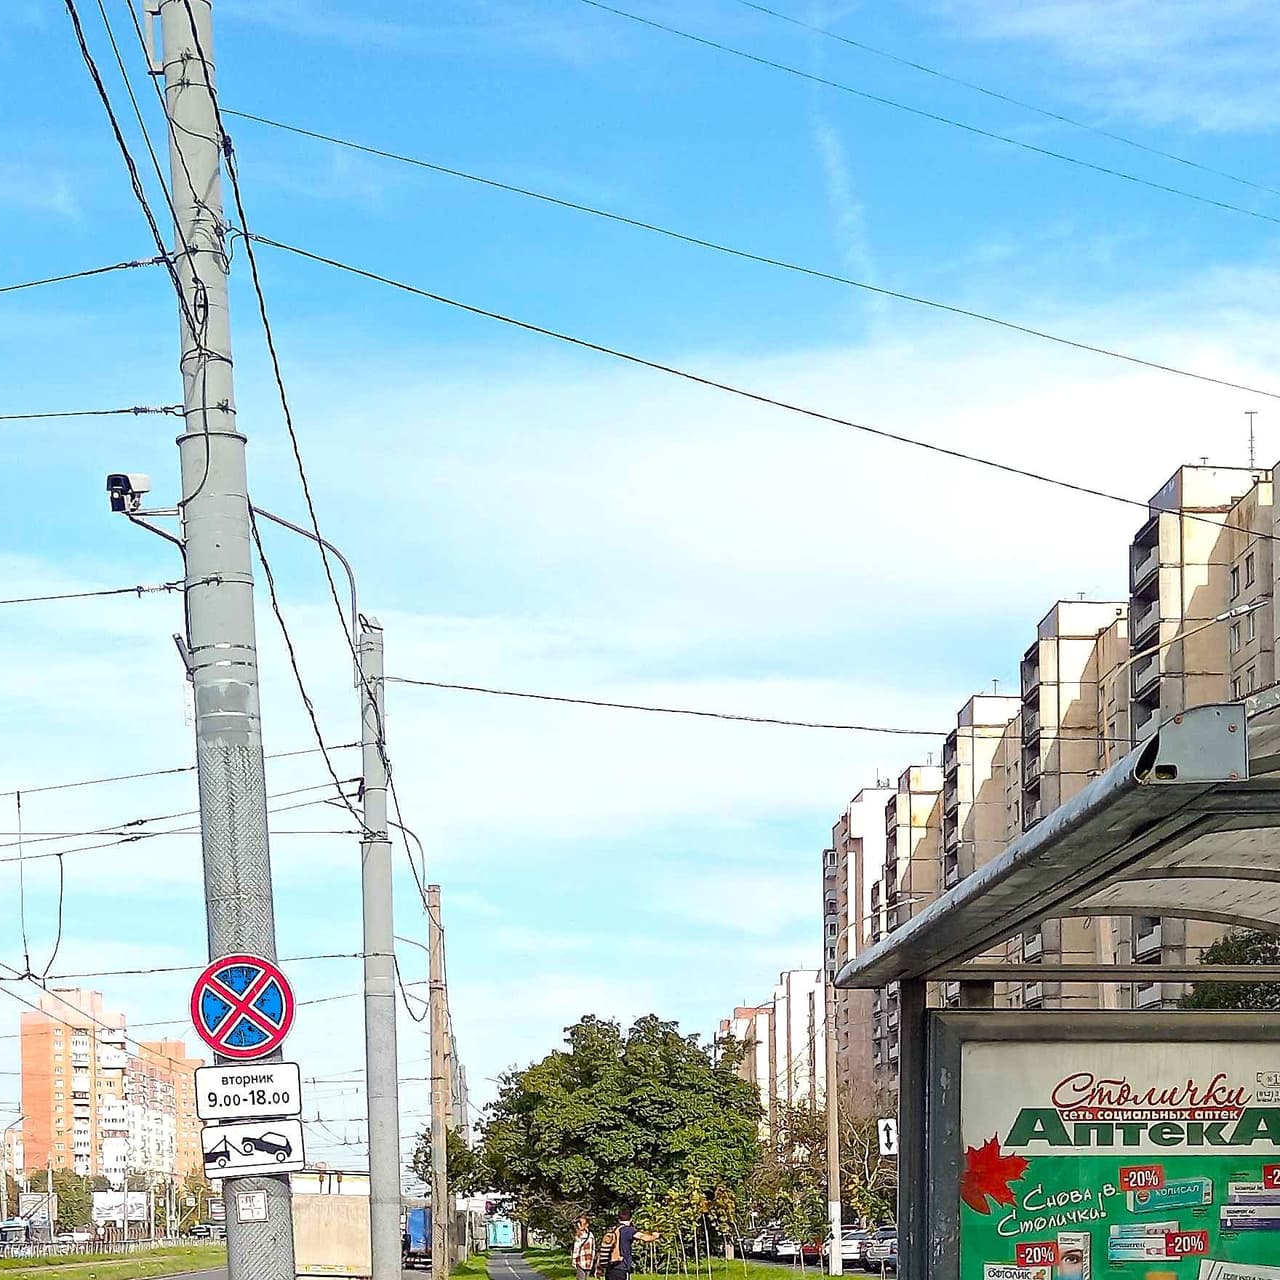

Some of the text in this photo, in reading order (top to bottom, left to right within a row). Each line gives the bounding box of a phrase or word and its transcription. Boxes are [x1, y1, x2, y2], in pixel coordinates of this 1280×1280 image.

[221, 1074, 274, 1088] вторник
[208, 1089, 290, 1108] 9.00-18.00
[1051, 1072, 1253, 1108] Столички
[1062, 1109, 1239, 1121] сеть социальных аптек
[1123, 1169, 1159, 1187] -20%
[1168, 1235, 1204, 1253] -20%
[1019, 1247, 1055, 1264] -20%
[988, 1269, 1032, 1280] ОФТОЛИК
